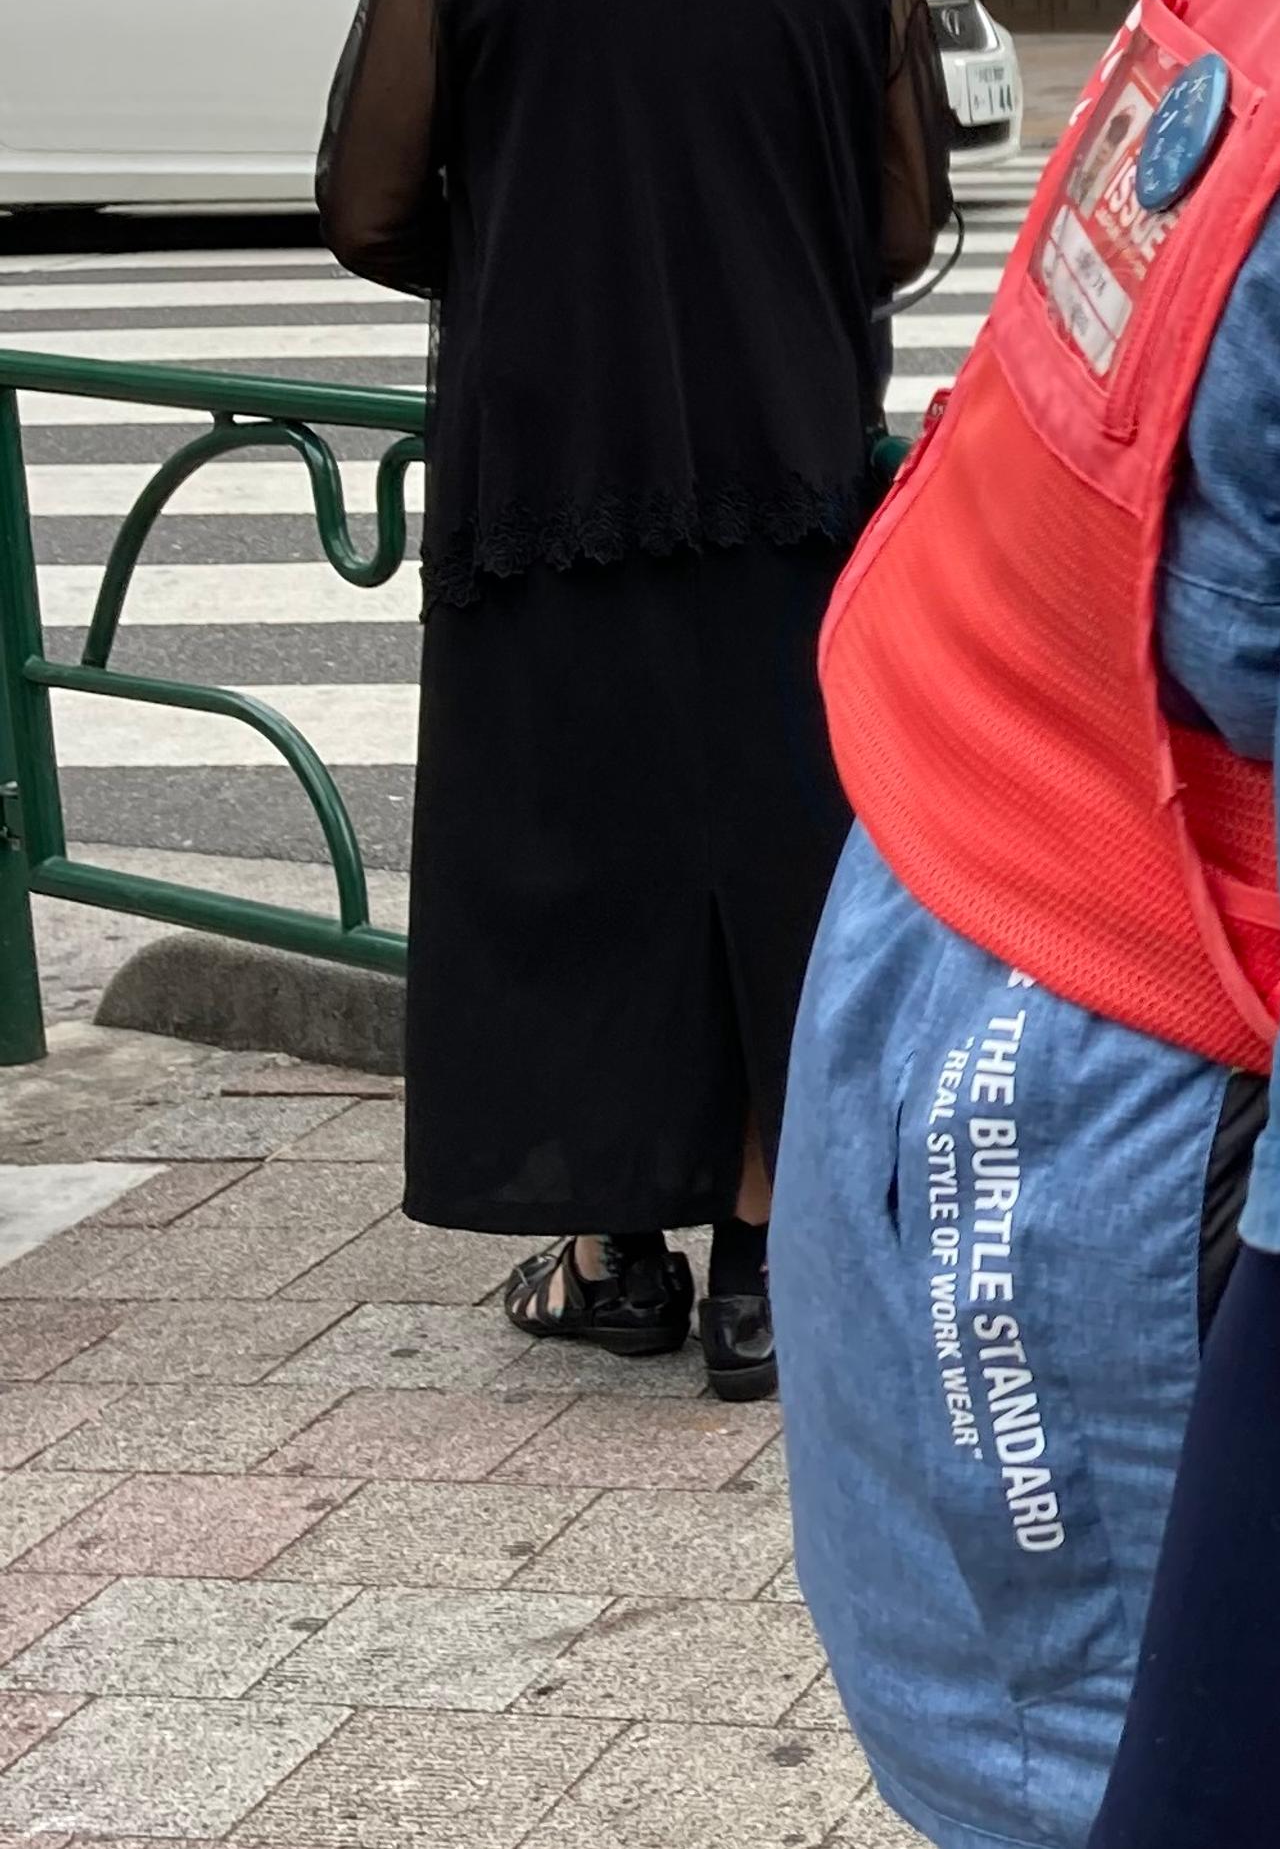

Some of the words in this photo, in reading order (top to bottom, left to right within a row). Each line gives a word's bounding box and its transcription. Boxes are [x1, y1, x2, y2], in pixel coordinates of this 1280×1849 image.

[970, 1008, 1026, 1106] THE
[926, 1132, 960, 1221] STYLE
[968, 1117, 1021, 1303] BURTLE
[930, 1226, 960, 1268] OF
[930, 1273, 962, 1361] WORK
[972, 1313, 1067, 1553] STANDARD
